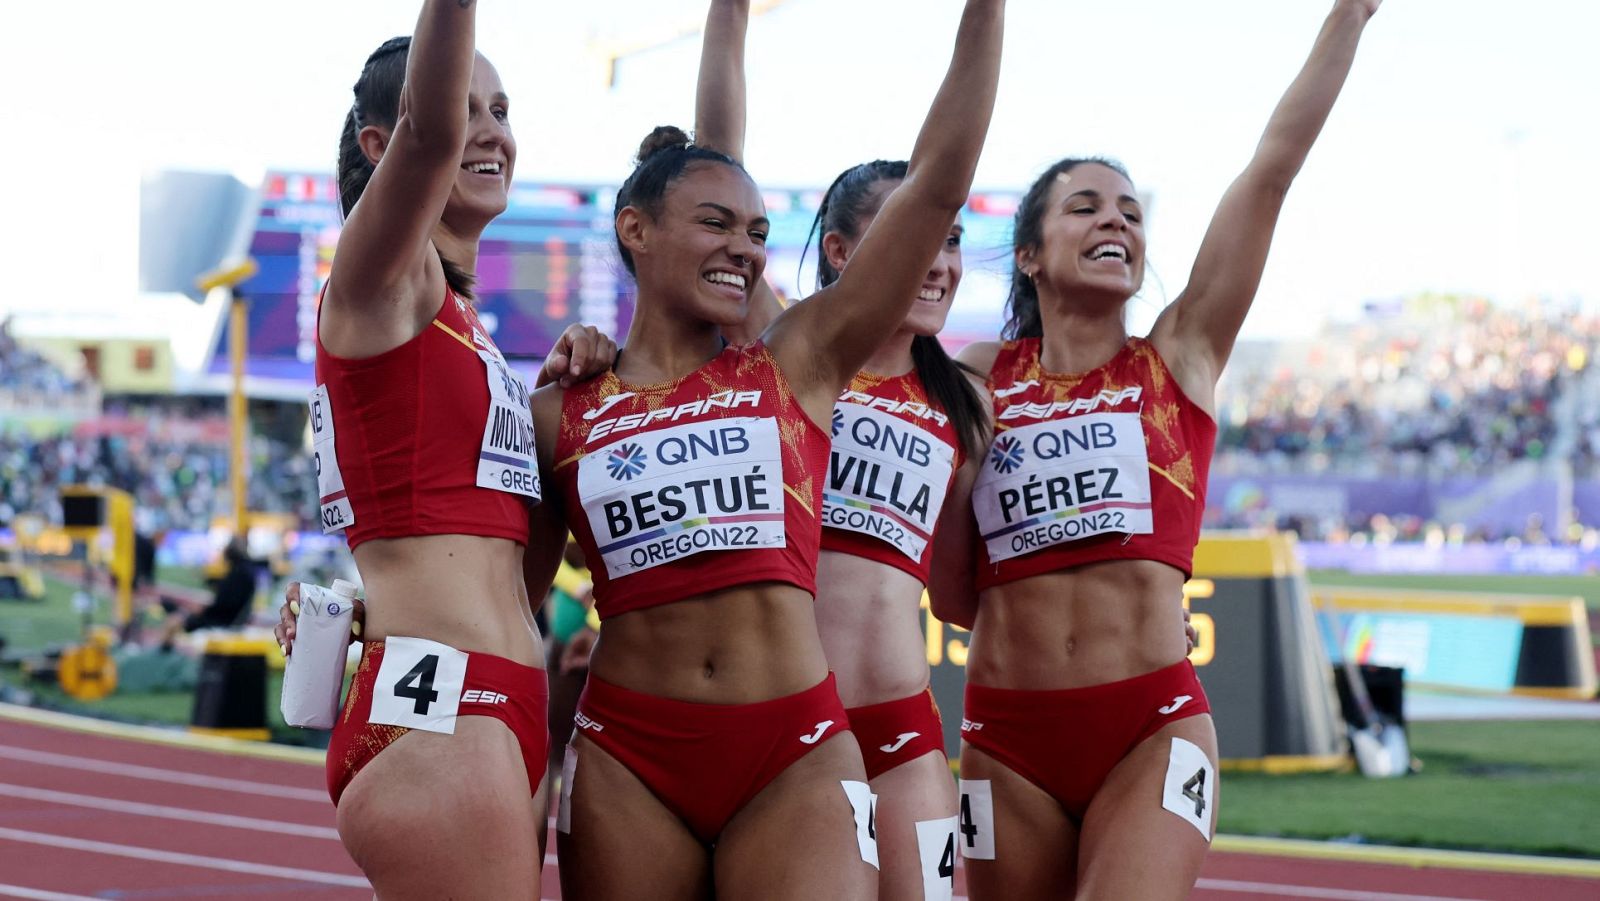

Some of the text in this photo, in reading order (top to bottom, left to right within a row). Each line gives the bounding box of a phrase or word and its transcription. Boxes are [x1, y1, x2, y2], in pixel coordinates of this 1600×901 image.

[585, 389, 762, 444] ESPAÑA
[838, 389, 950, 429] PAÑA
[998, 387, 1143, 420] ESPAÑA
[655, 427, 750, 466] QNB
[851, 417, 931, 467] QNB
[1032, 422, 1118, 460] QNB
[603, 465, 770, 540] BESTUÉ
[830, 451, 932, 525] VILLA
[998, 468, 1123, 524] PÉREZ
[630, 526, 759, 568] OREGON22
[1011, 512, 1126, 553] OREGON22
[393, 653, 440, 716] 4
[460, 689, 509, 706] ESP
[1181, 766, 1206, 820] 4
[960, 793, 978, 848] 4
[938, 831, 955, 889] 4
